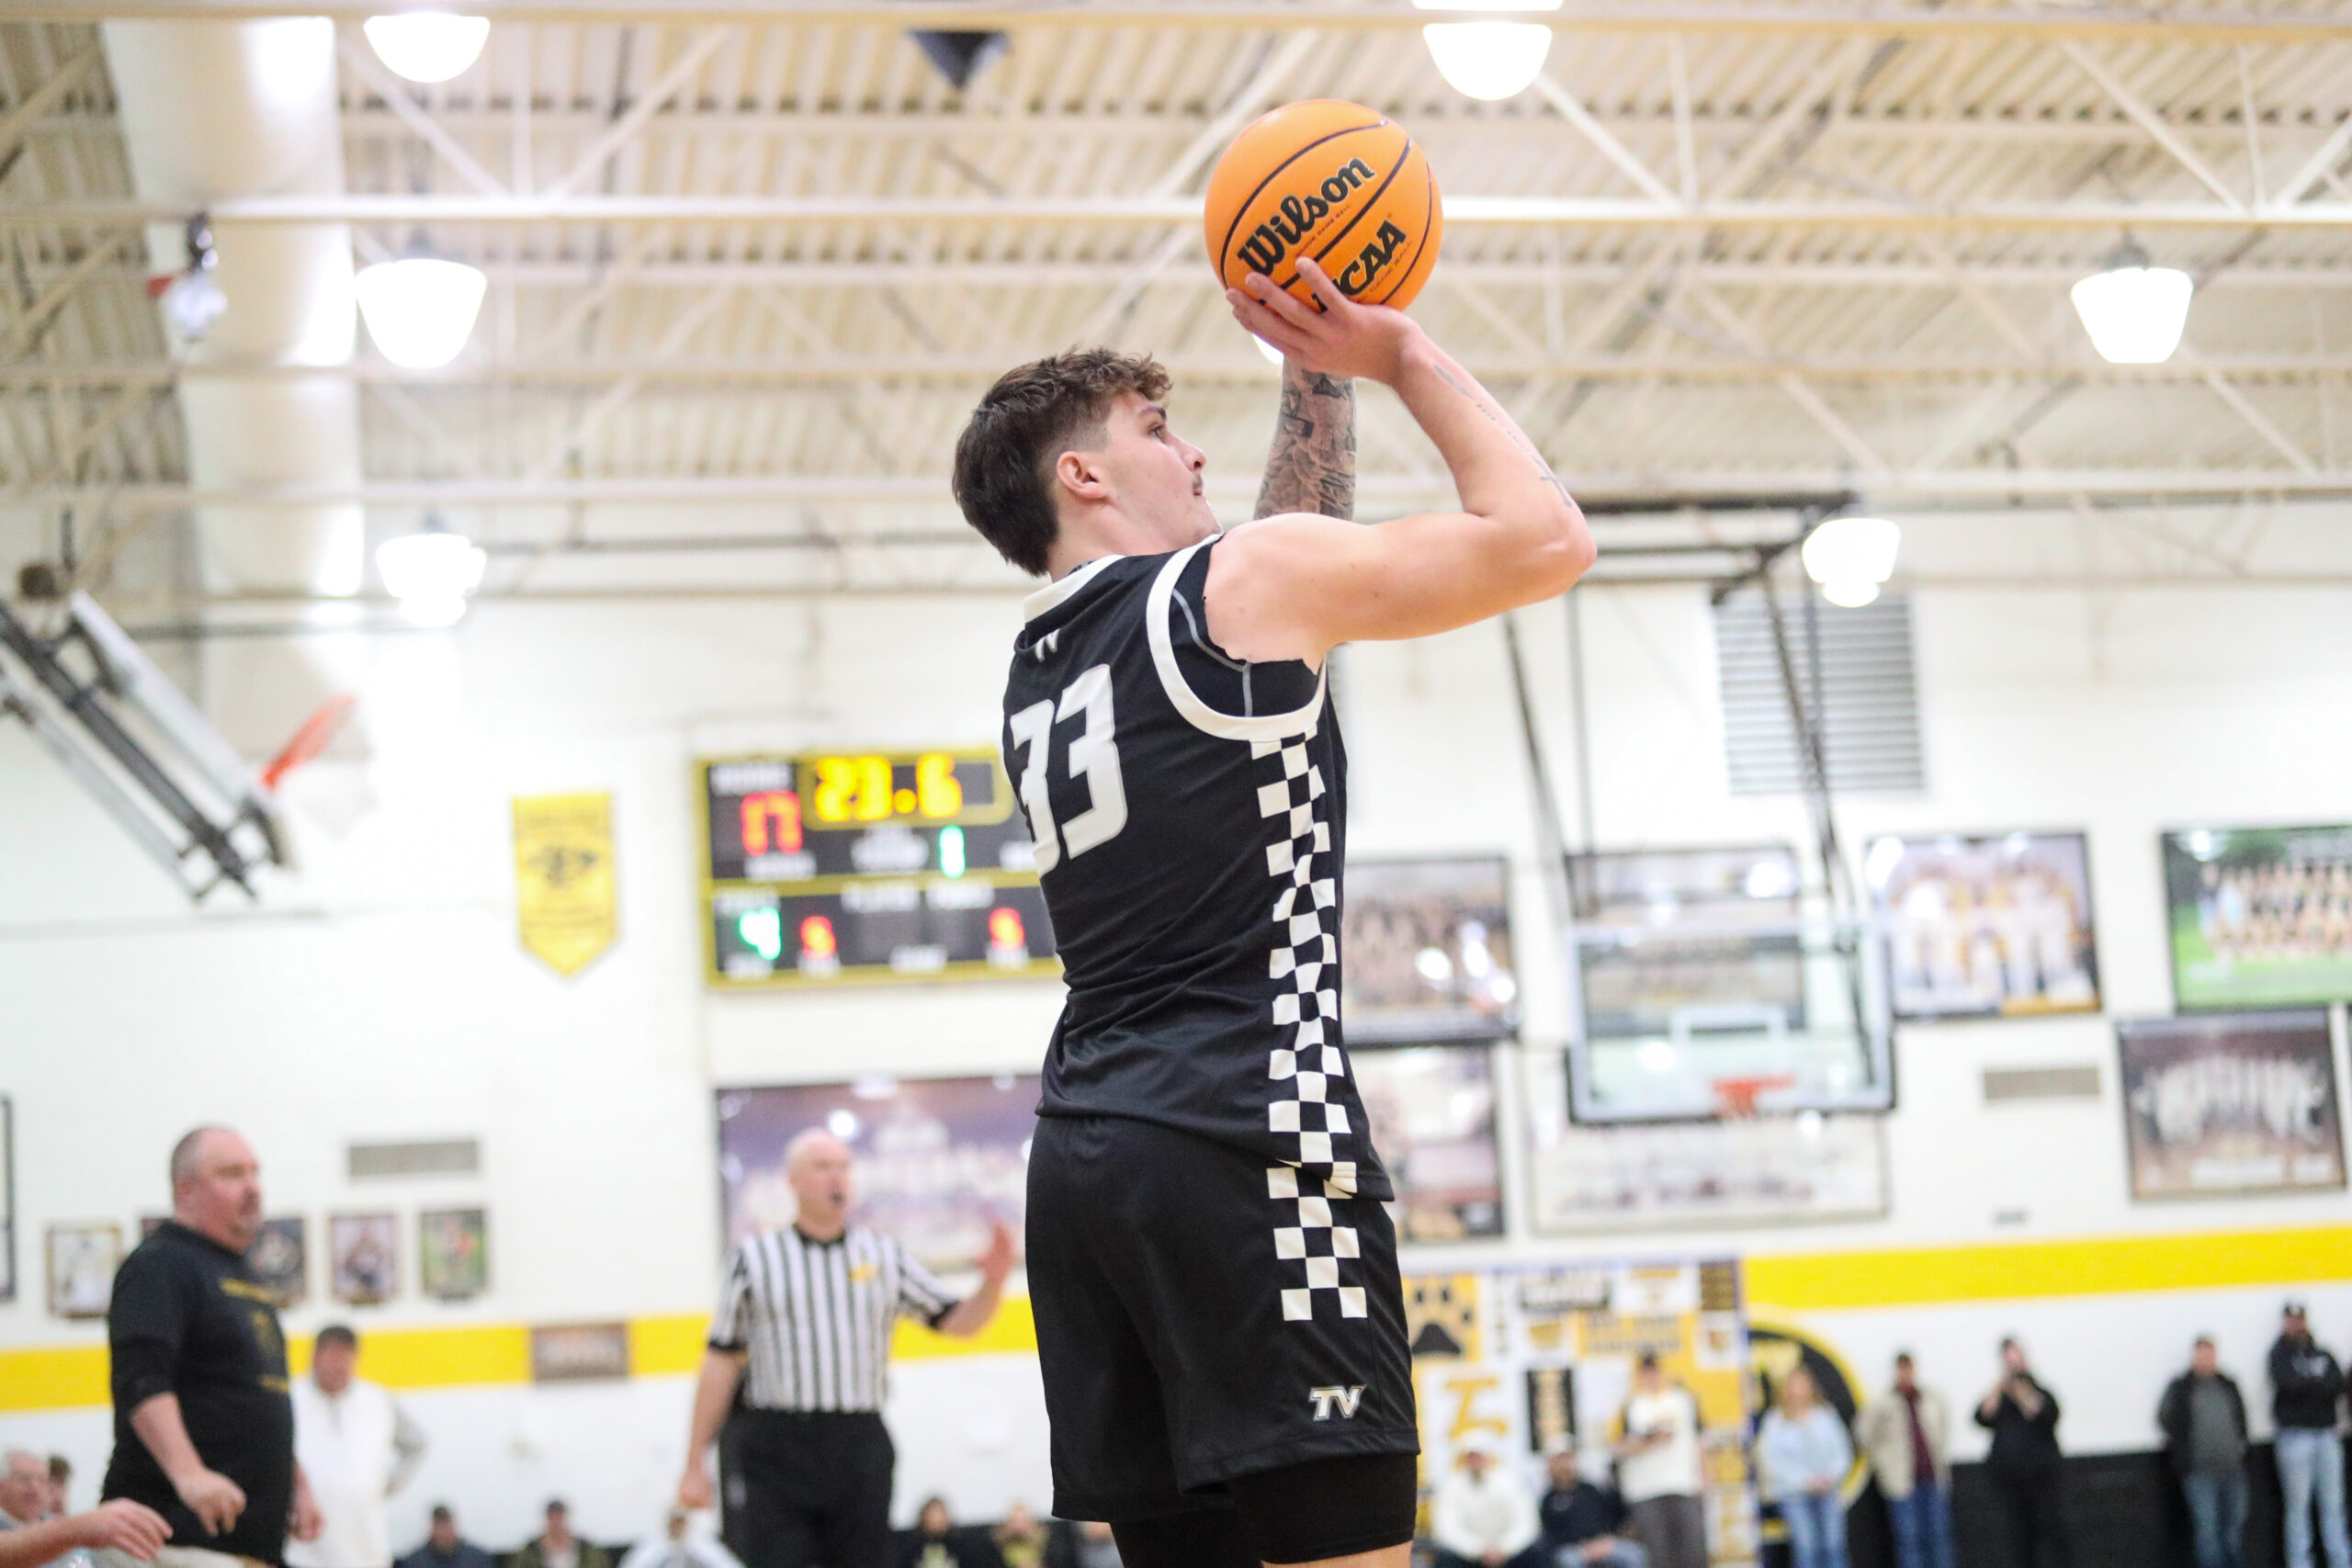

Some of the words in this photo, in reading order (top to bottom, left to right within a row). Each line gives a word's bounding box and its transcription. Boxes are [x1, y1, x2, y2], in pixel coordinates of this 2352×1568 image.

[1237, 157, 1375, 276] Wilson
[1010, 663, 1128, 879] 33
[1308, 1384, 1366, 1421] TV
